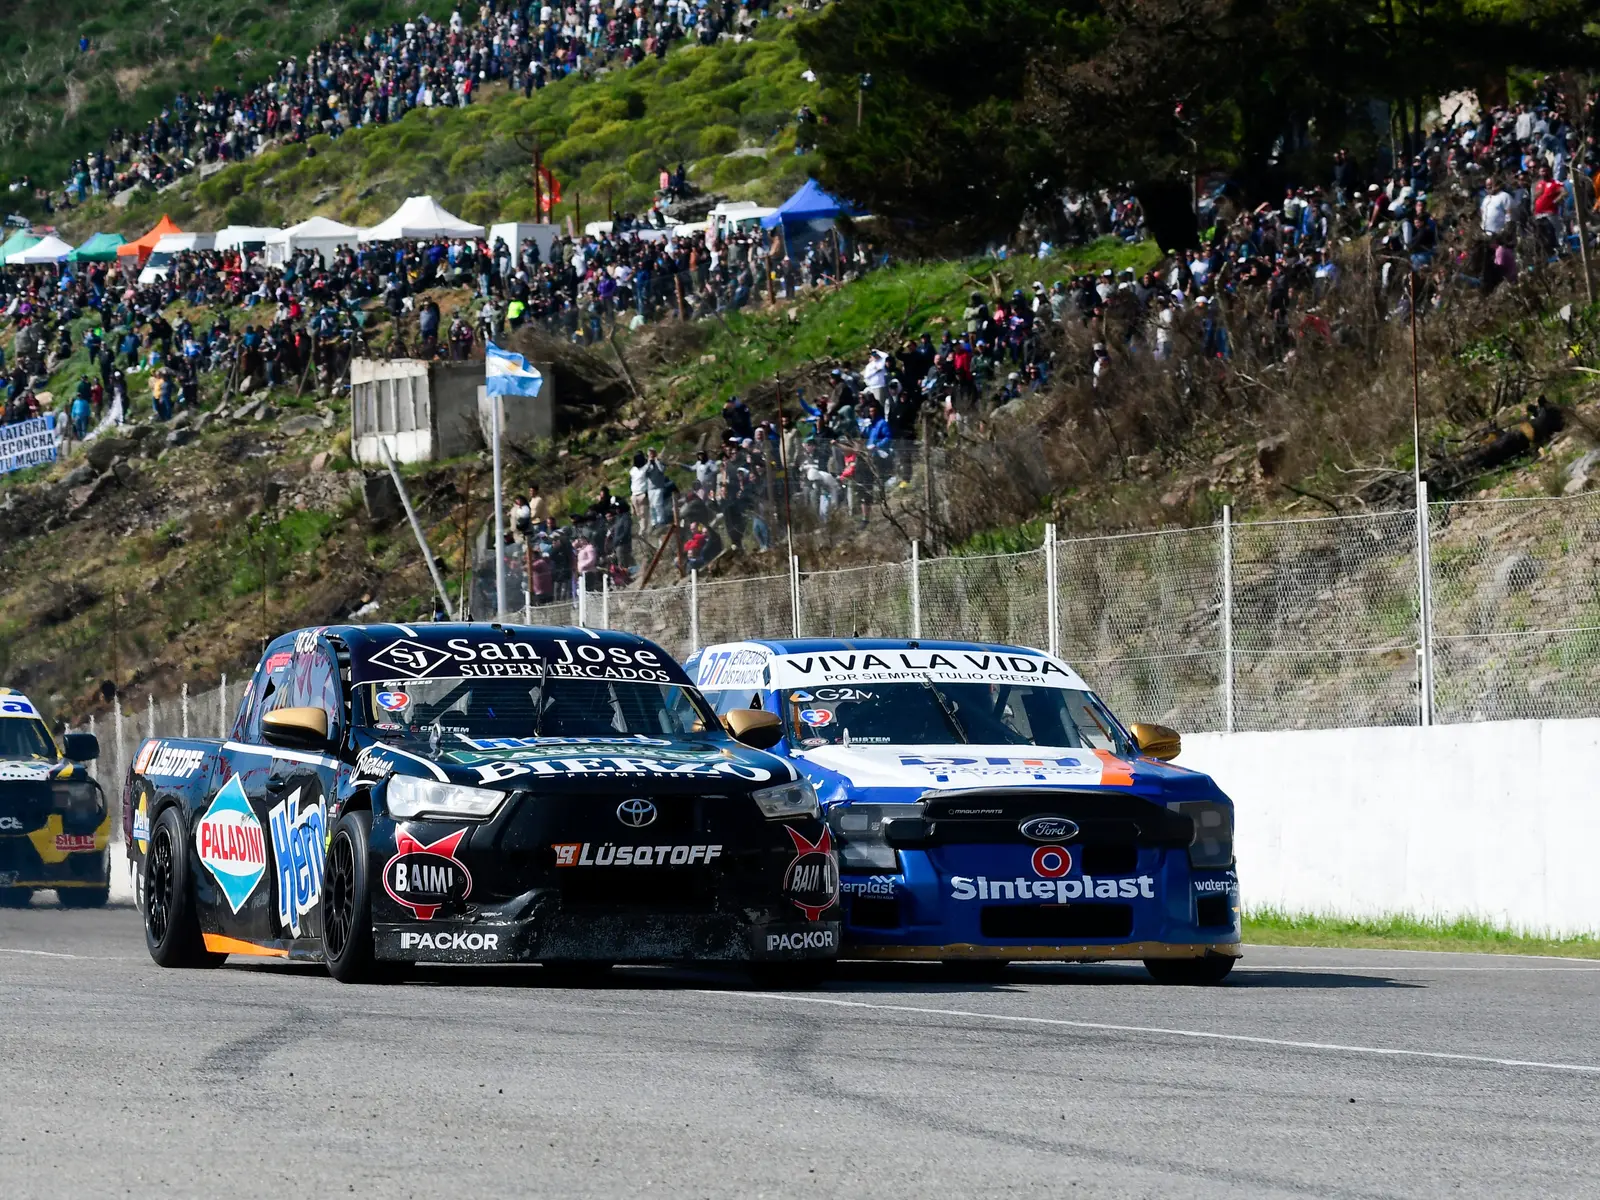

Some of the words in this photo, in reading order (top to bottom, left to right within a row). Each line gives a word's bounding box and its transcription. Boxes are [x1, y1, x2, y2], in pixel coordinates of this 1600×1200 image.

[0, 433, 54, 457] ECONCHA
[16, 447, 53, 466] MADRE
[447, 637, 541, 662] San
[553, 639, 662, 668] Jose
[459, 663, 671, 683] SUPERMERCADOS
[787, 653, 892, 674] VIVA
[898, 653, 948, 672] LA
[963, 654, 1069, 678] VIDA
[824, 674, 859, 683] POR
[862, 672, 934, 682] SIEMPRE
[935, 672, 984, 682] TULIO
[986, 673, 1046, 684] CRESPI
[467, 757, 772, 785] BIERZO
[566, 771, 696, 779] FIAMBRES
[1035, 822, 1066, 836] Ford
[201, 821, 265, 865] PALADINI
[950, 875, 1155, 904] Sinteplast
[400, 931, 499, 950] PACKOR
[766, 930, 834, 952] PACKOR
